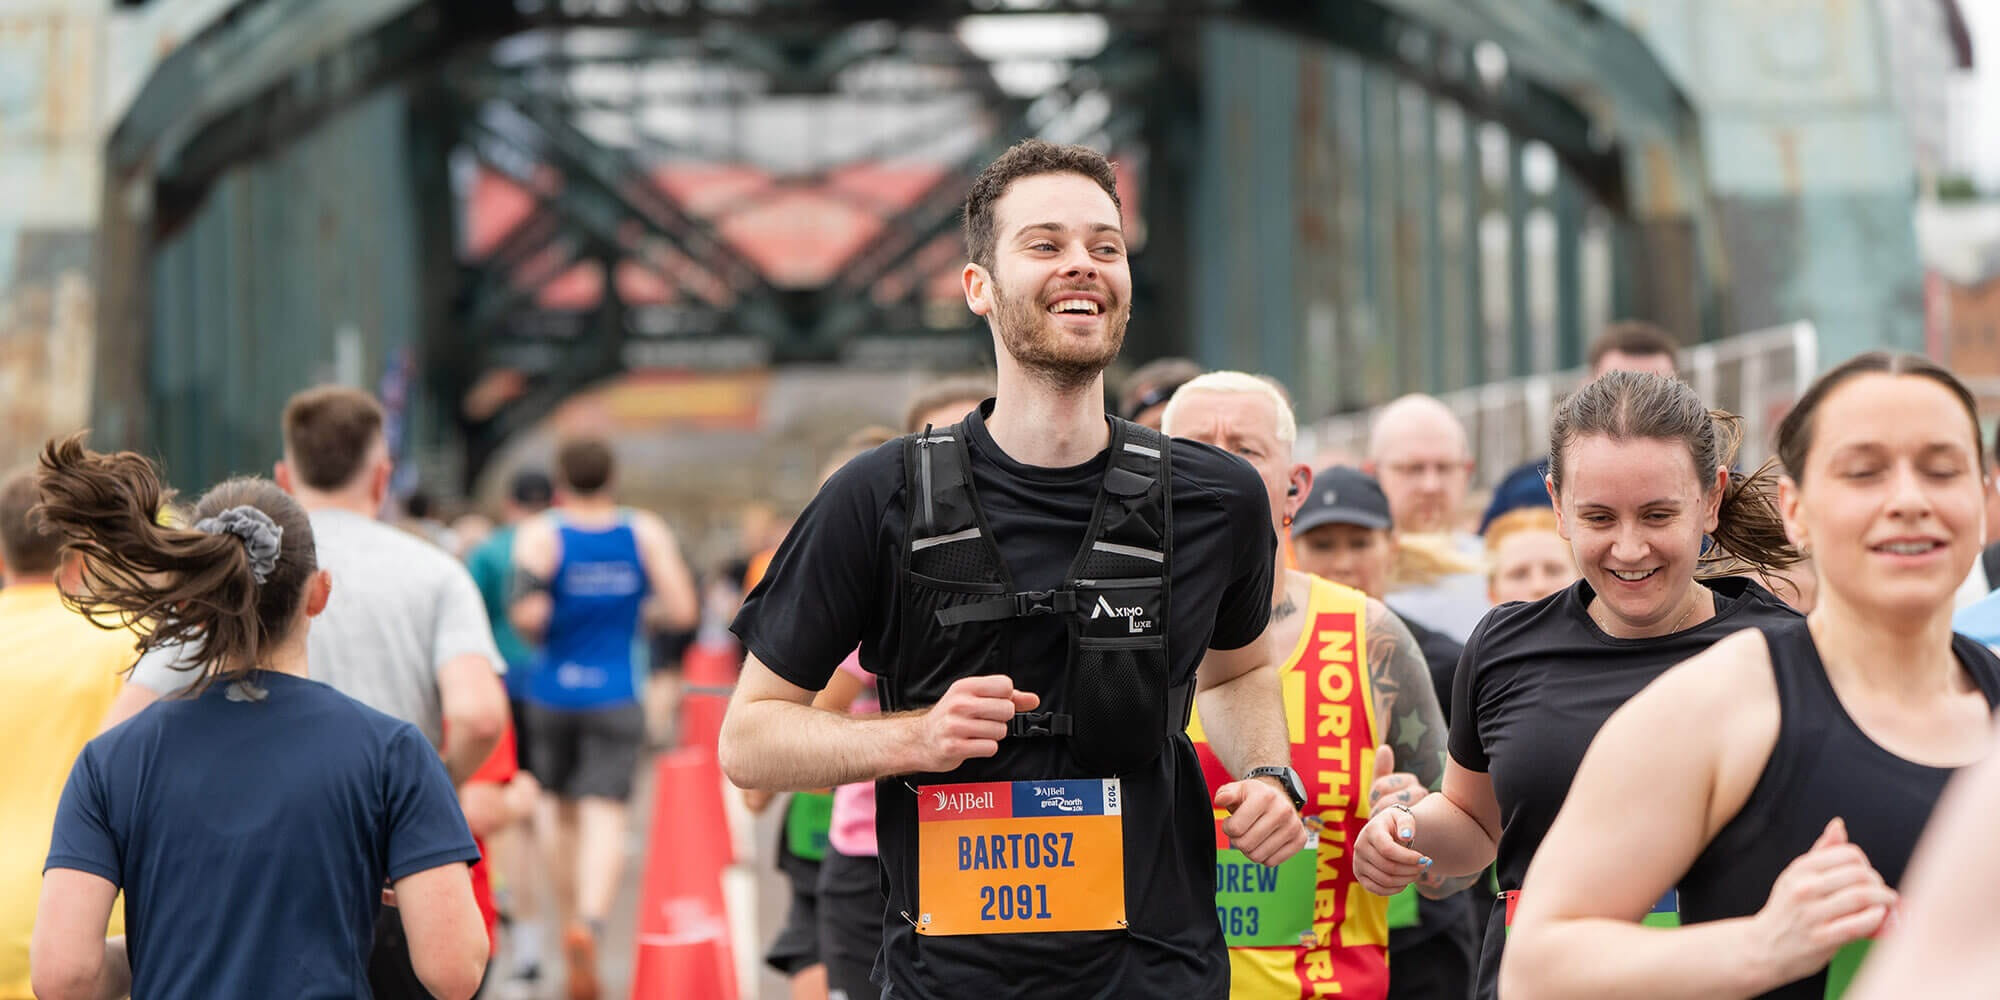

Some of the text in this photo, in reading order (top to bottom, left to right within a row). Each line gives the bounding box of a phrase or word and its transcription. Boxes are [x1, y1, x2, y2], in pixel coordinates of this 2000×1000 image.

[1064, 798, 1083, 806] north
[1107, 785, 1117, 808] 2025
[958, 832, 1075, 871] BARTOSZ
[980, 884, 1052, 920] 2091
